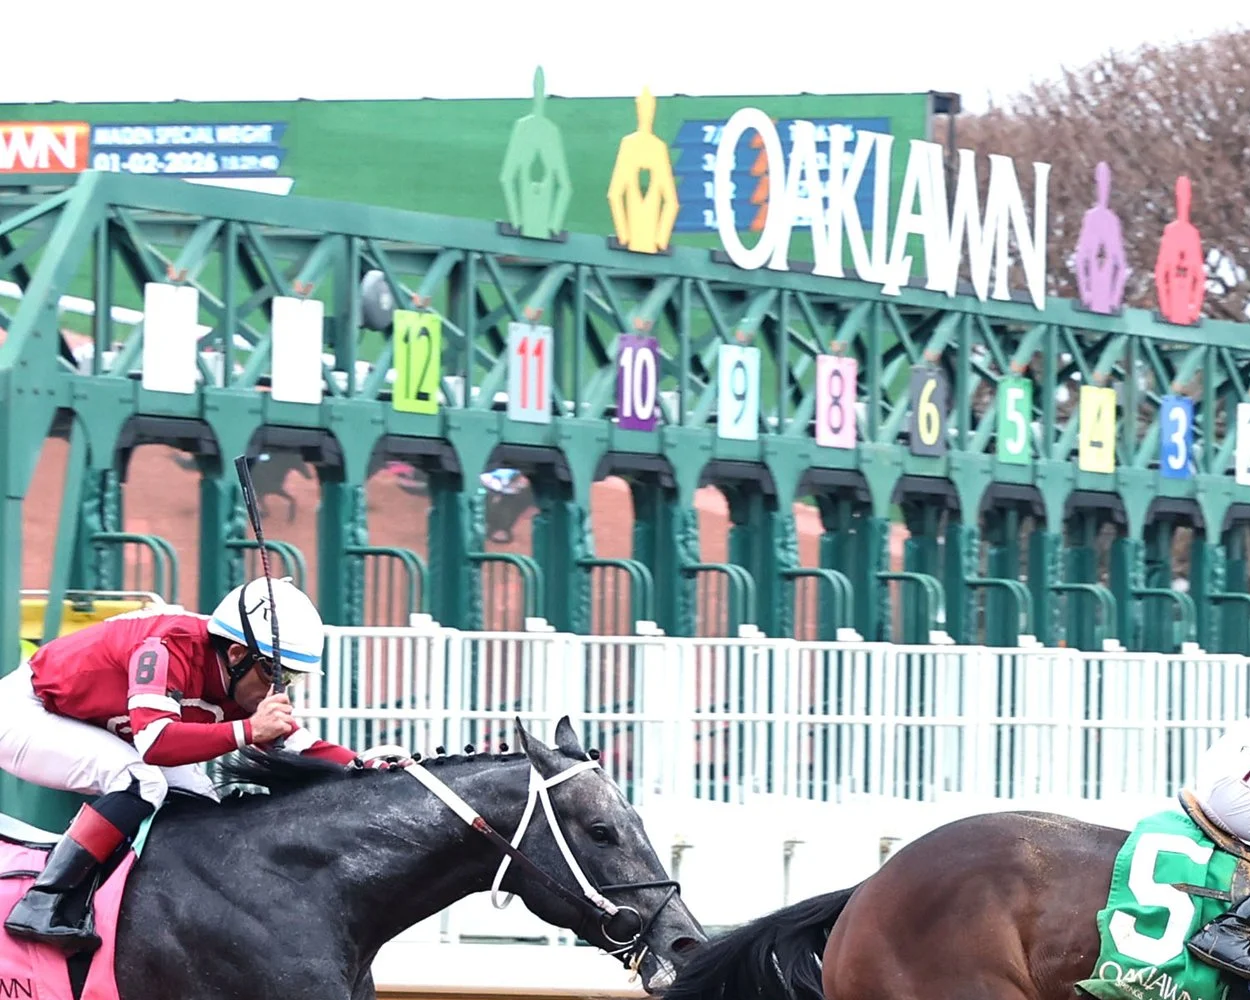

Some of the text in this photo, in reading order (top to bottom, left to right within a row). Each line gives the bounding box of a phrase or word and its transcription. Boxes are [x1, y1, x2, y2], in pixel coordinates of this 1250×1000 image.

[714, 107, 1051, 311] OAKLAWN
[402, 325, 433, 402] 12
[516, 337, 545, 410] 11
[620, 345, 655, 421] 10
[731, 360, 748, 424] 9
[828, 368, 844, 435] 8
[918, 378, 940, 446] 6
[1005, 386, 1027, 455] 5
[1168, 406, 1188, 470] 3
[136, 650, 158, 685] 8
[1108, 832, 1214, 966] 5
